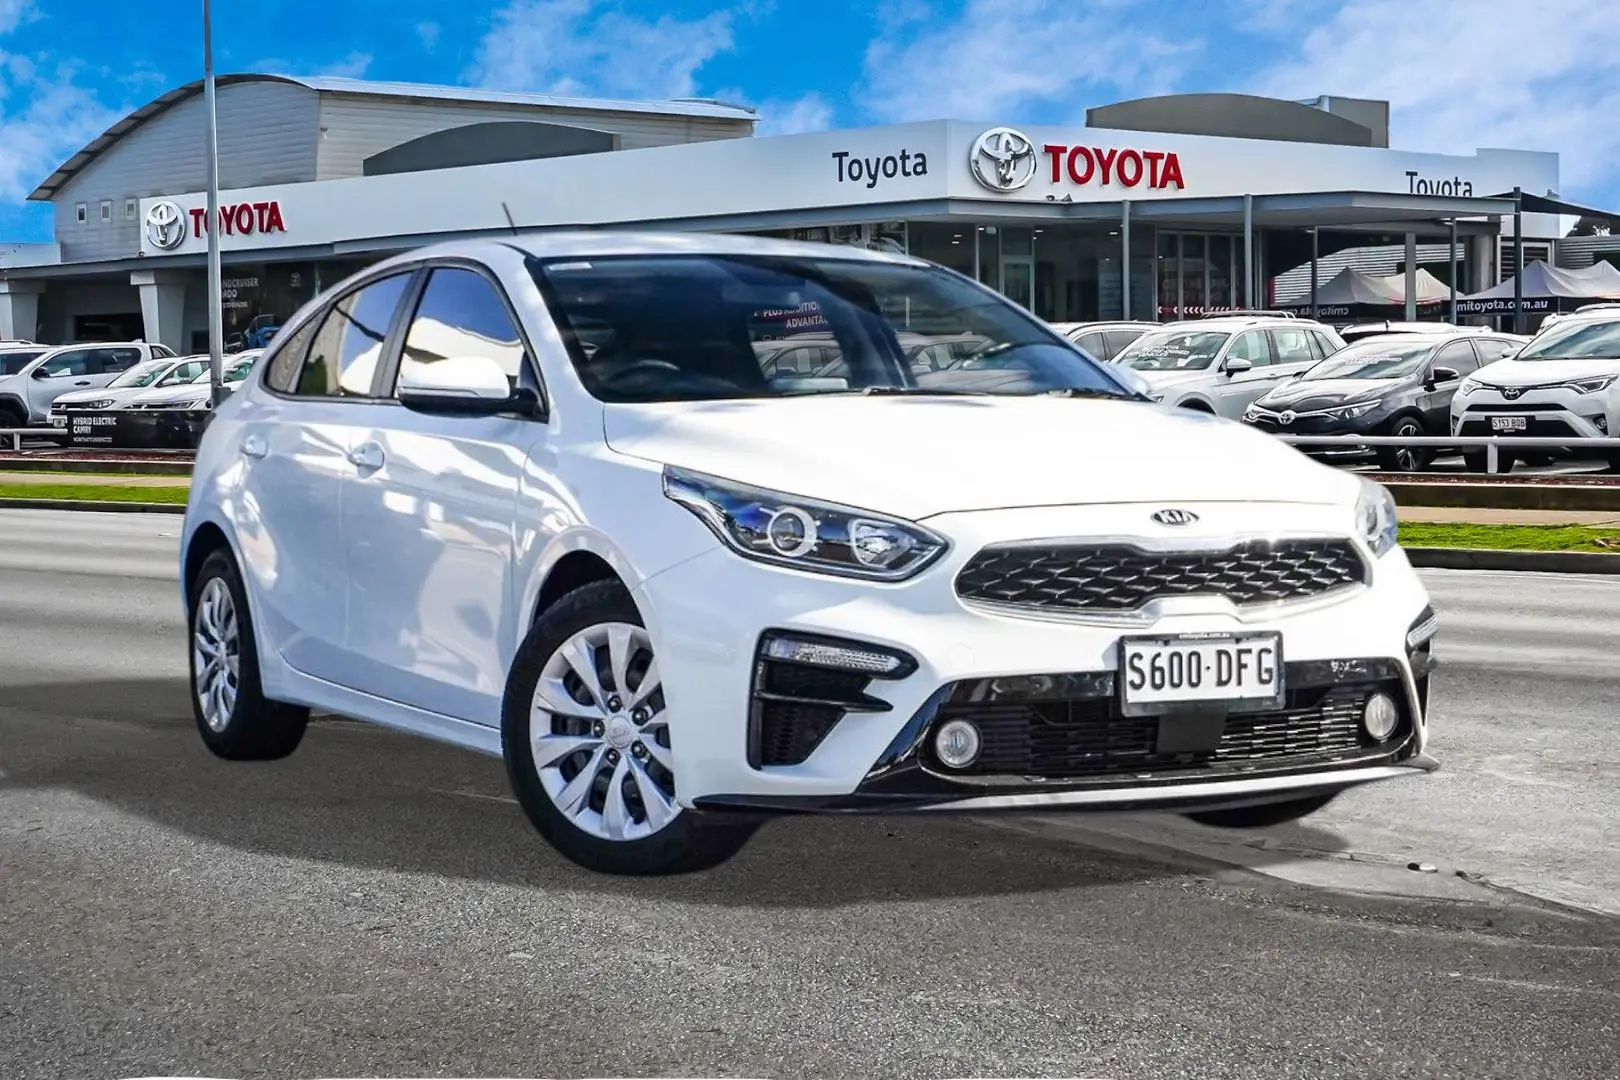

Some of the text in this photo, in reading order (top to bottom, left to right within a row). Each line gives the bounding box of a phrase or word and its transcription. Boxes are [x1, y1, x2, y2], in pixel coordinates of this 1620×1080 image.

[832, 148, 928, 189] Toyota
[1043, 143, 1185, 190] TOYOTA
[1457, 299, 1549, 313] mitoyota.cm.au
[73, 417, 92, 425] HYBRID
[93, 417, 117, 425] ELECTRIC
[1158, 509, 1198, 523] KIA
